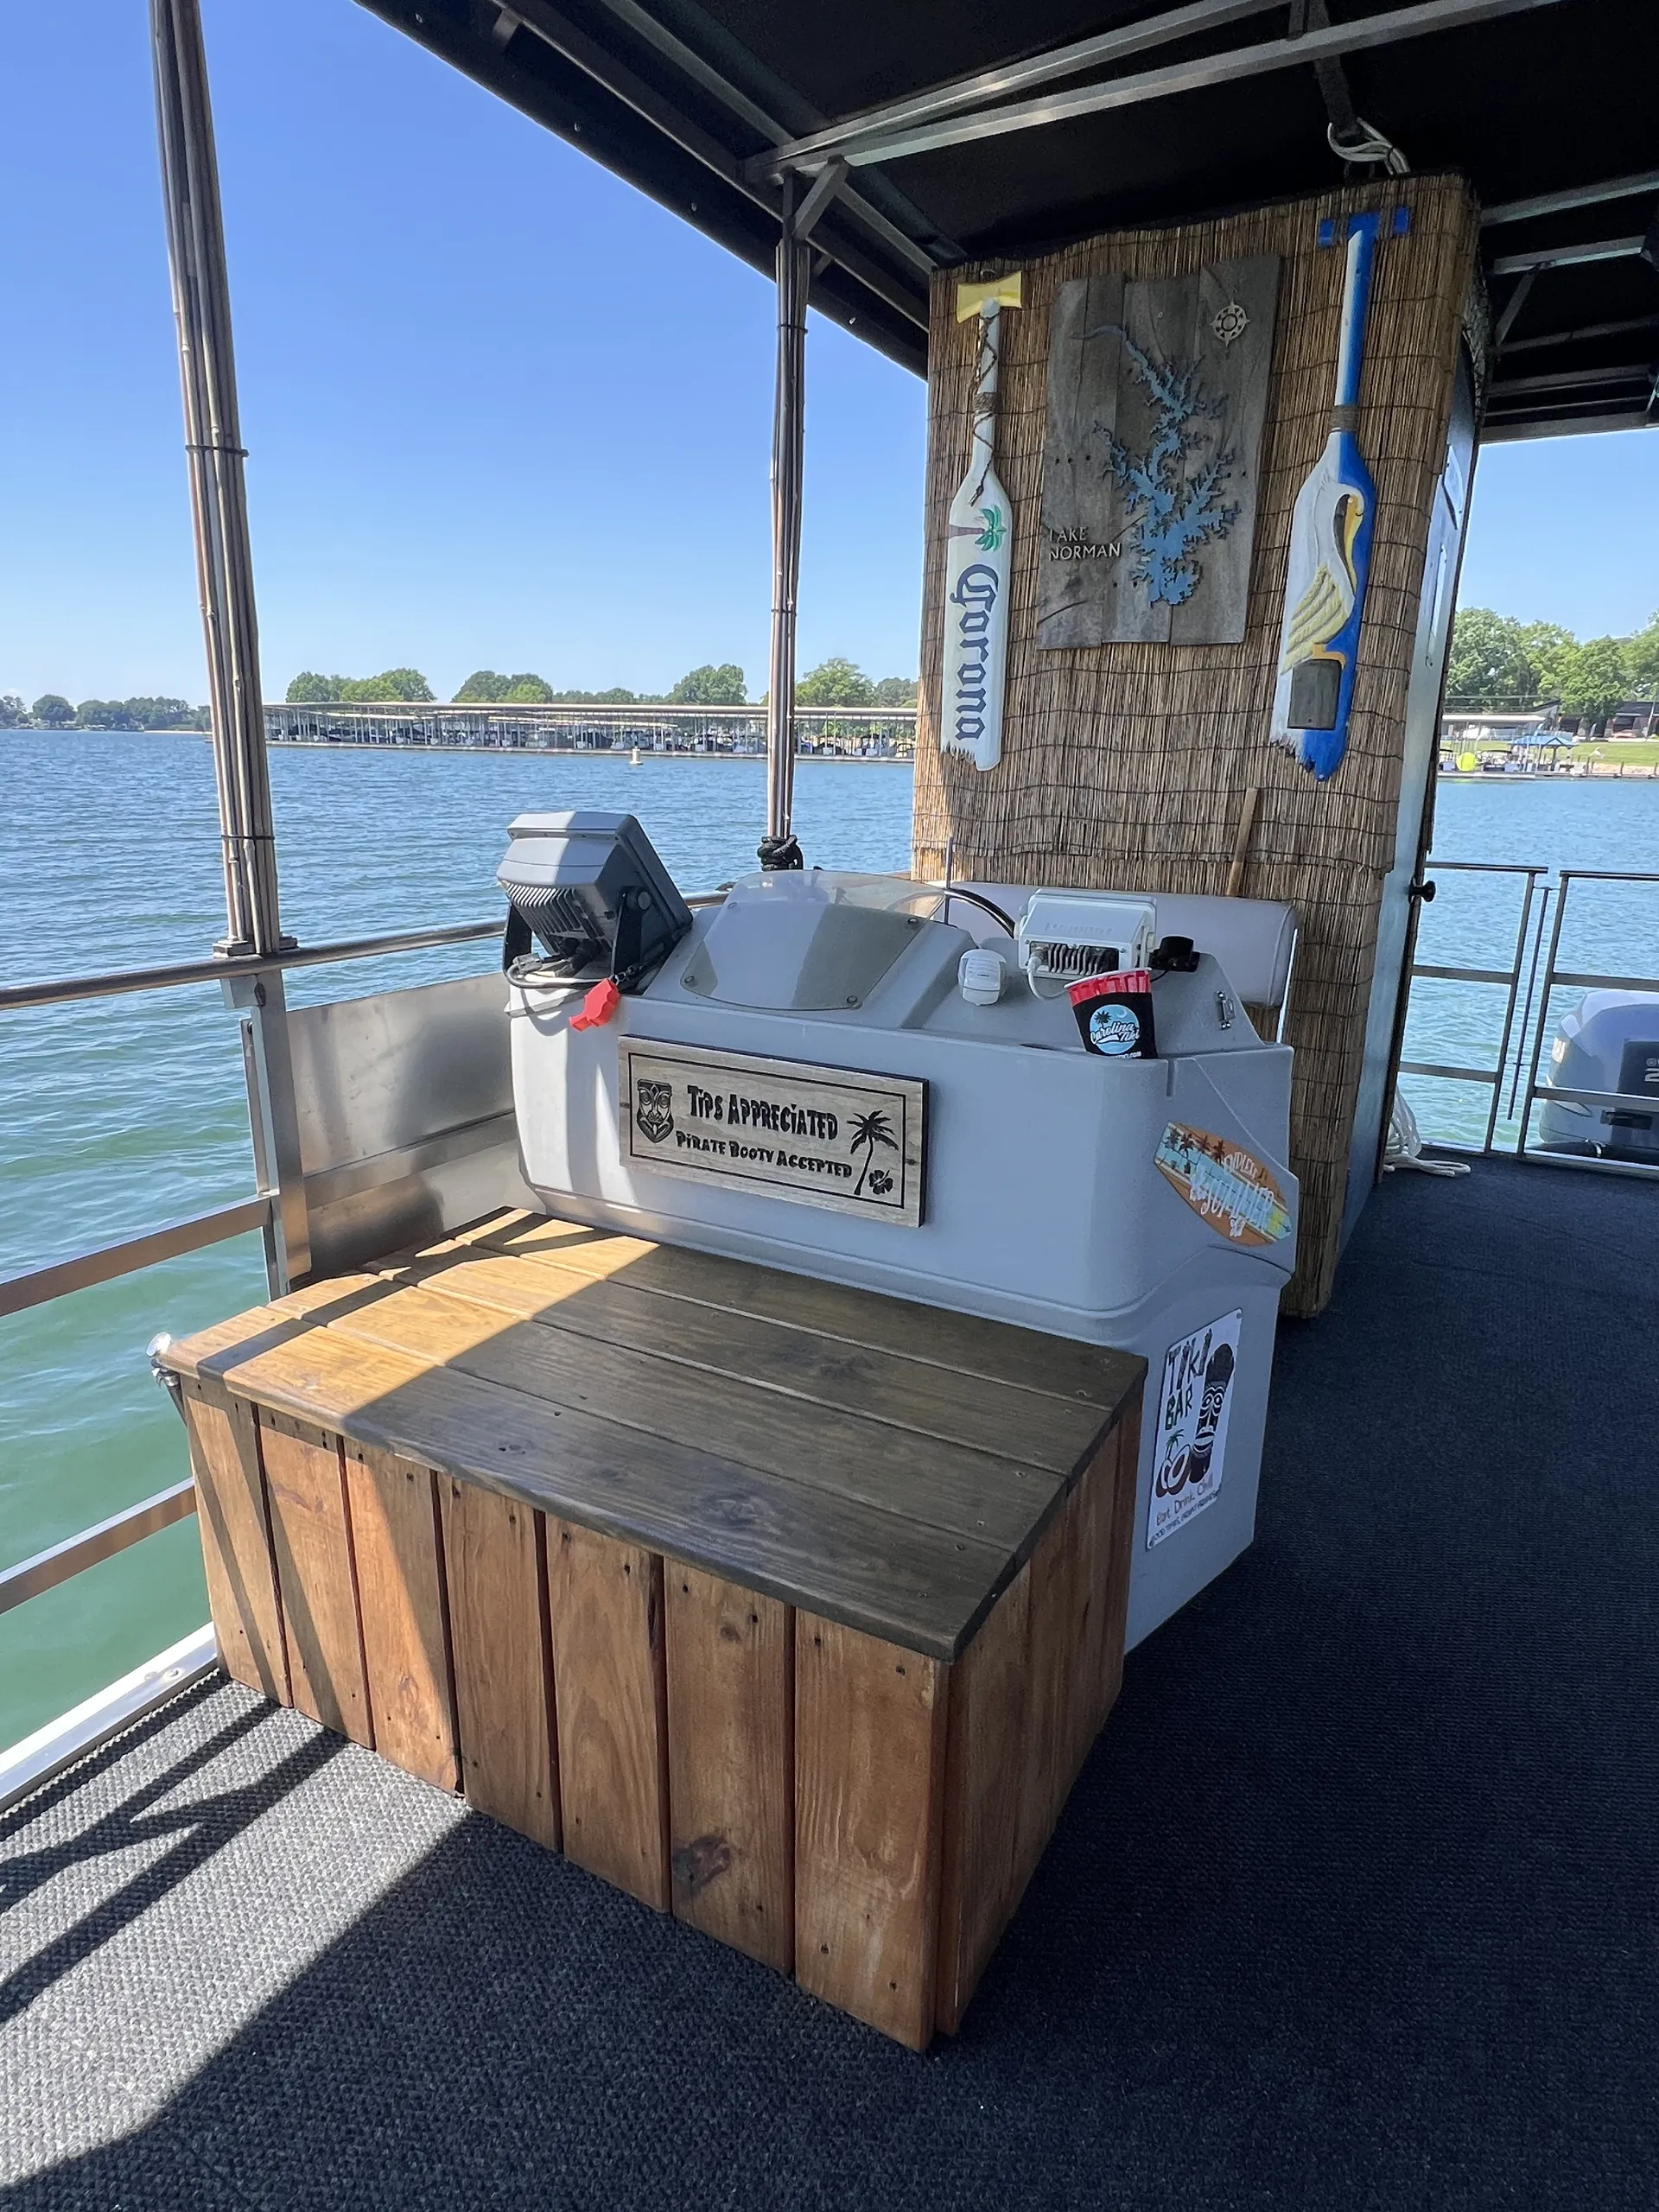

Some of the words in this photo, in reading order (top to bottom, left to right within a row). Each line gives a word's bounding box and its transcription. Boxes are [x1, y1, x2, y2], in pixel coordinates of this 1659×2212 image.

[1048, 542, 1122, 562] NORMAN
[950, 563, 999, 741] Corona
[1090, 1021, 1135, 1045] Carolina
[1118, 1028, 1140, 1042] Tiki
[1168, 1328, 1212, 1396] TIKI
[1165, 1382, 1193, 1431] BAR
